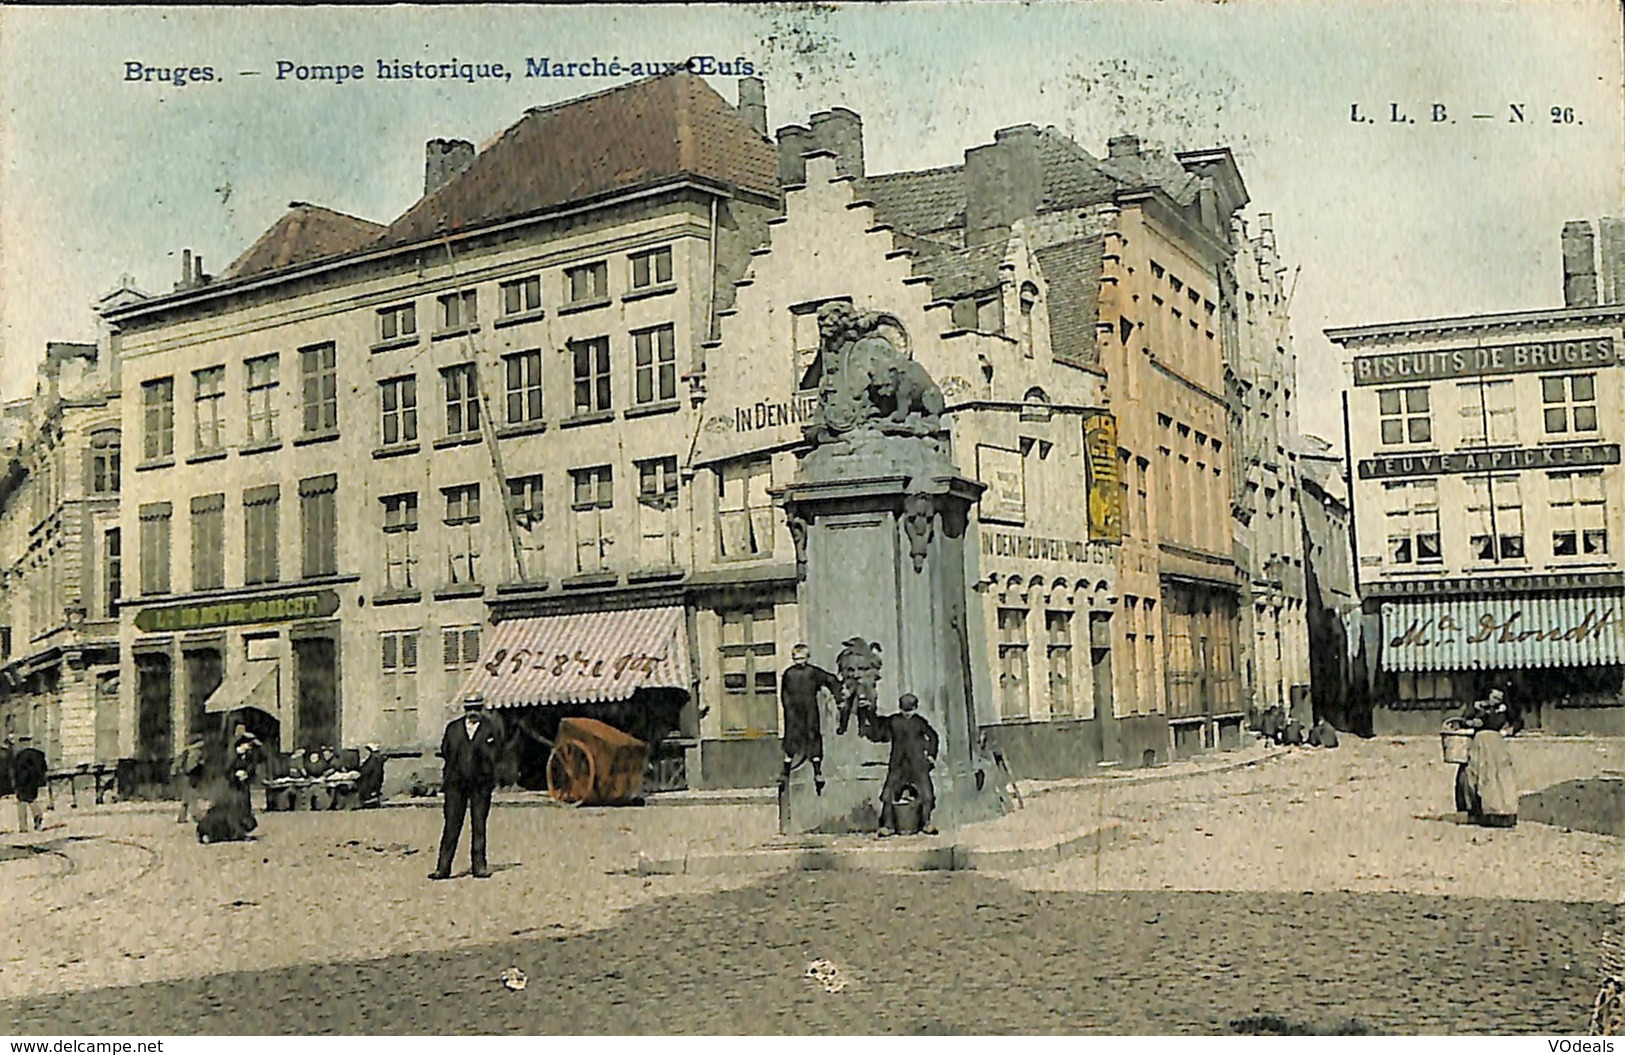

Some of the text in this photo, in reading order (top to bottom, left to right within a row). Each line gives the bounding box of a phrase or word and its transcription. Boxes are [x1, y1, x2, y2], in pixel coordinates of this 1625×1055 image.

[1358, 341, 1610, 379] BISCUITS DE BRUGES
[735, 406, 752, 433] IN
[1366, 455, 1451, 475] VEUVE
[1491, 446, 1611, 468] PICKERY
